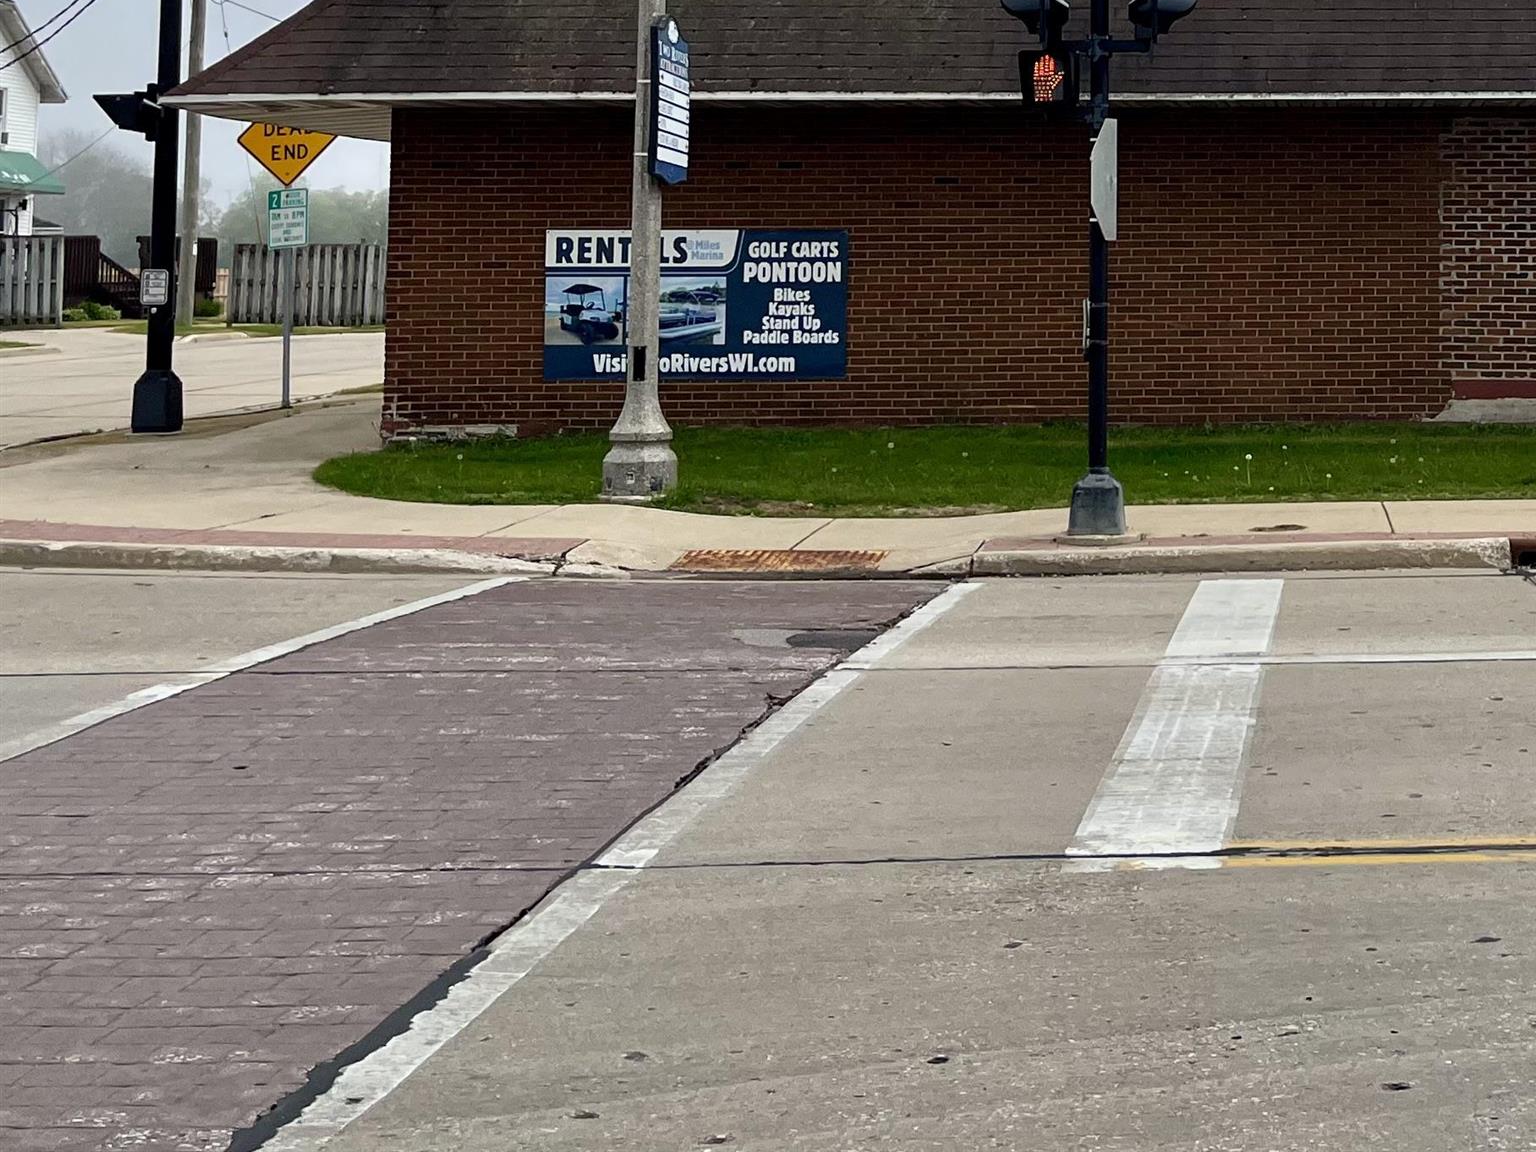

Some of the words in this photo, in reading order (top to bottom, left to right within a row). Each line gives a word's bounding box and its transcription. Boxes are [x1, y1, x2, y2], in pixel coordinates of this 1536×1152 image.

[271, 144, 308, 161] END
[272, 194, 278, 208] 2
[556, 236, 688, 264] RENTLS
[691, 250, 723, 260] Marina
[748, 241, 788, 258] GOLF
[791, 241, 839, 258] CARTS
[743, 261, 842, 283] PONTOON
[773, 288, 811, 302] Bikes
[768, 302, 815, 317] Kayaks
[761, 316, 799, 330] Stand
[803, 316, 821, 331] Up
[743, 330, 789, 344] Paddle
[792, 330, 839, 344] Boards
